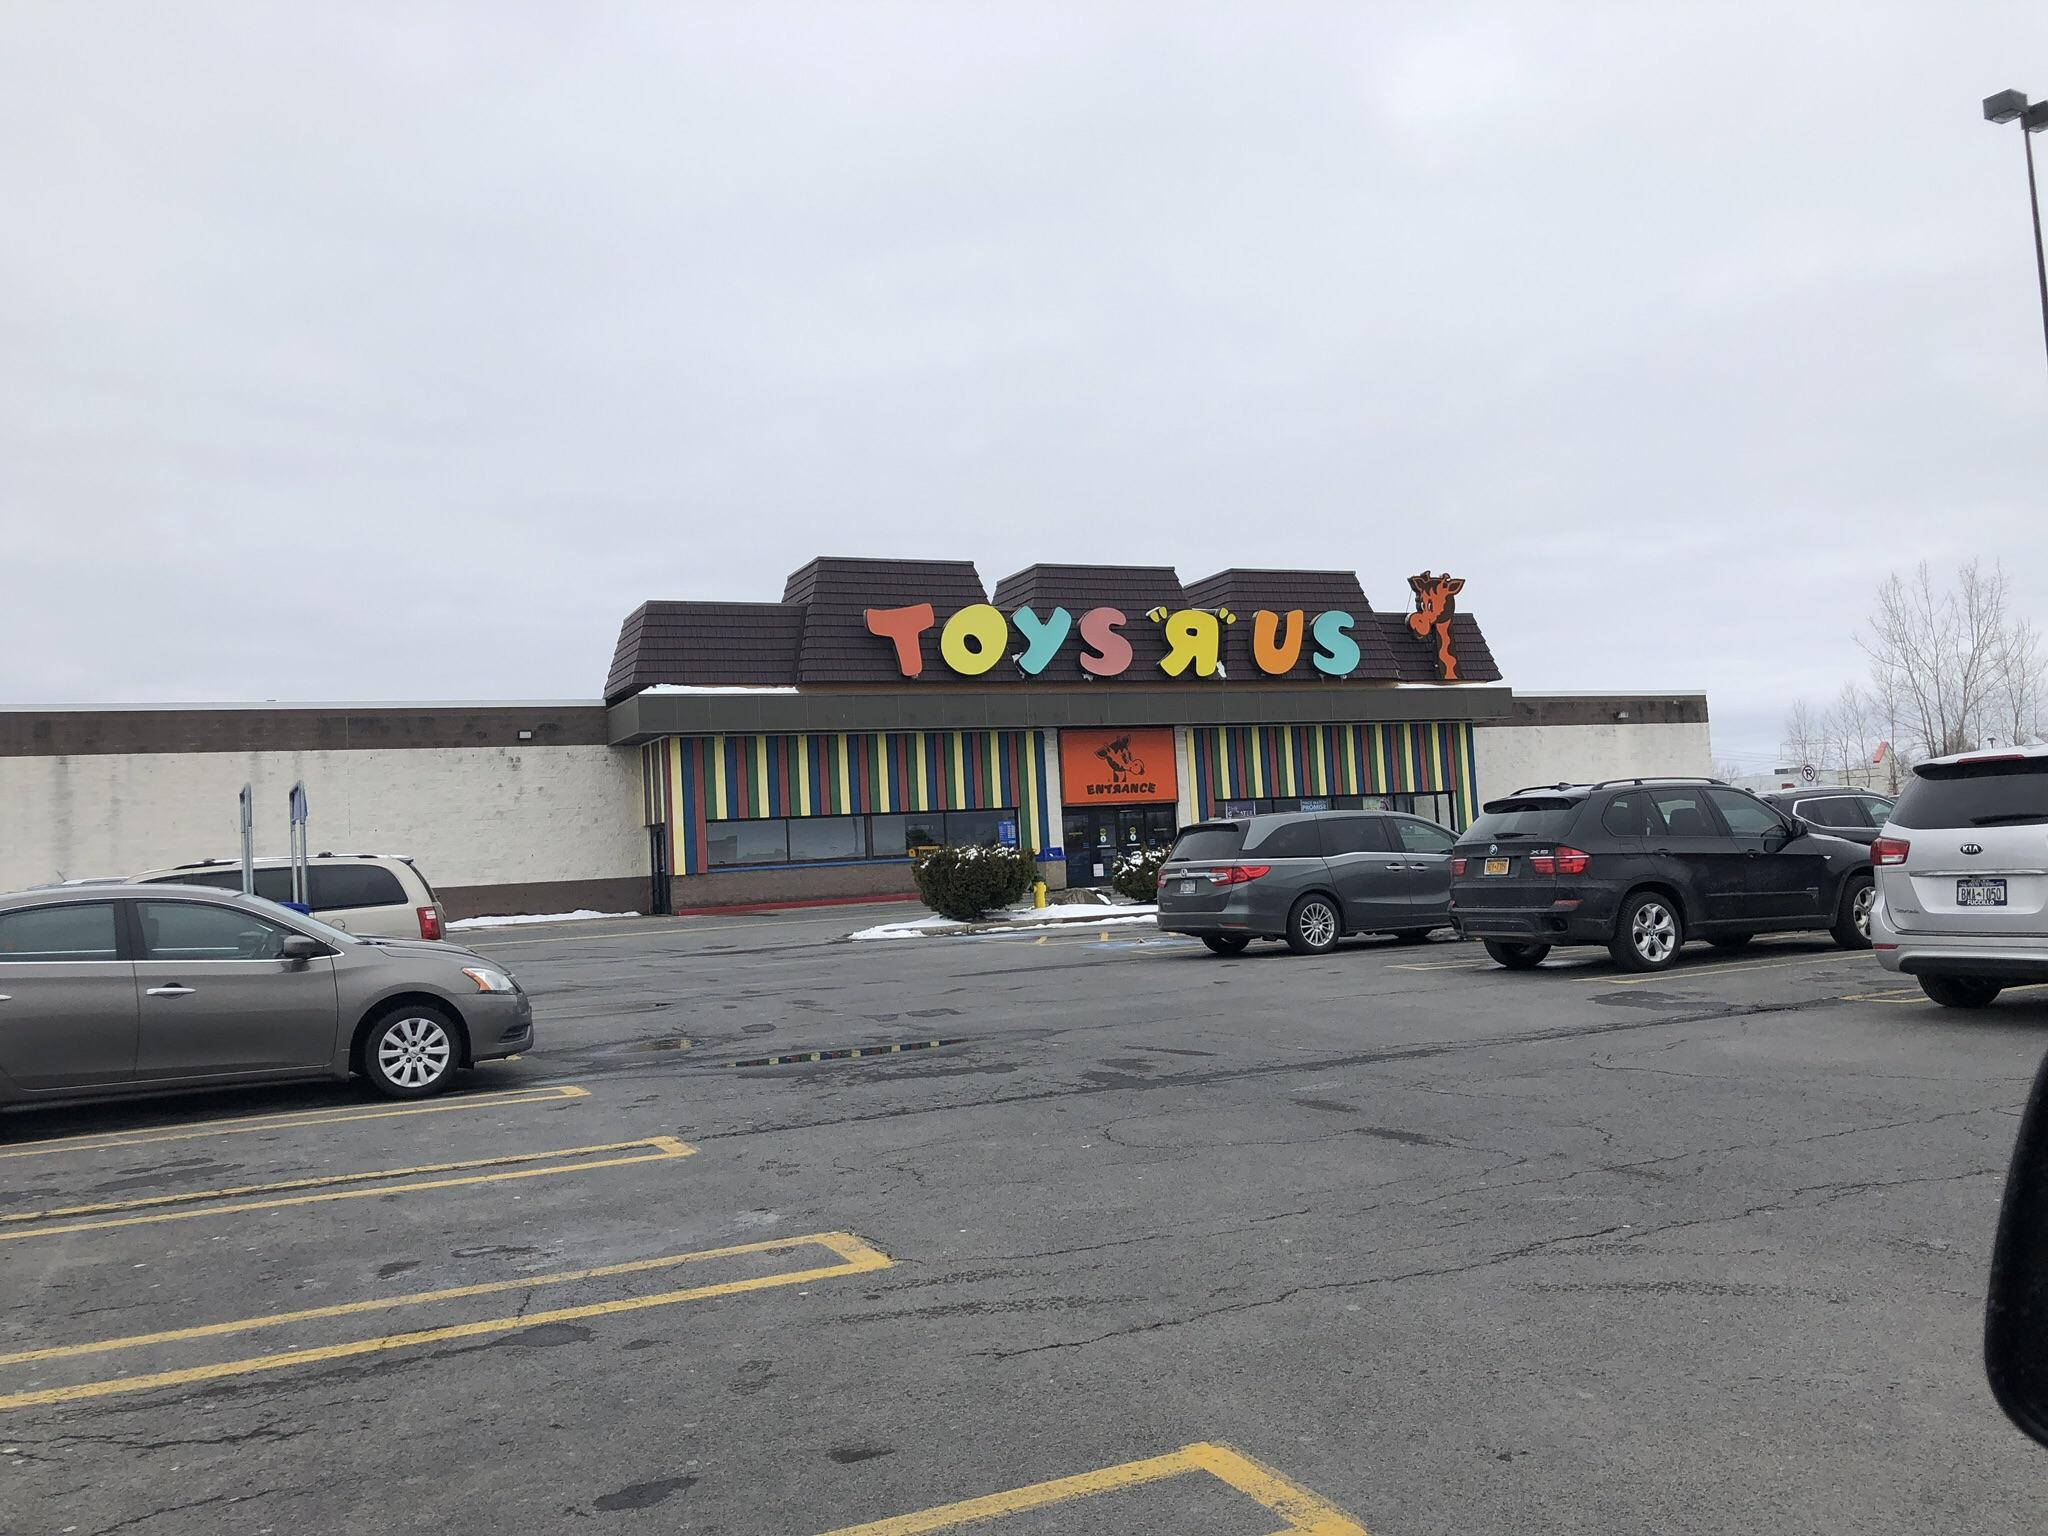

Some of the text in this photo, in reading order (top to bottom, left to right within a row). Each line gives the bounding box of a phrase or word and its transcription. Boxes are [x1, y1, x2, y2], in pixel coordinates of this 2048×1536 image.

[865, 603, 1133, 676] TOYS
[1253, 609, 1361, 675] US
[1087, 783, 1156, 795] ENTRANCE
[1962, 845, 1980, 853] KIA
